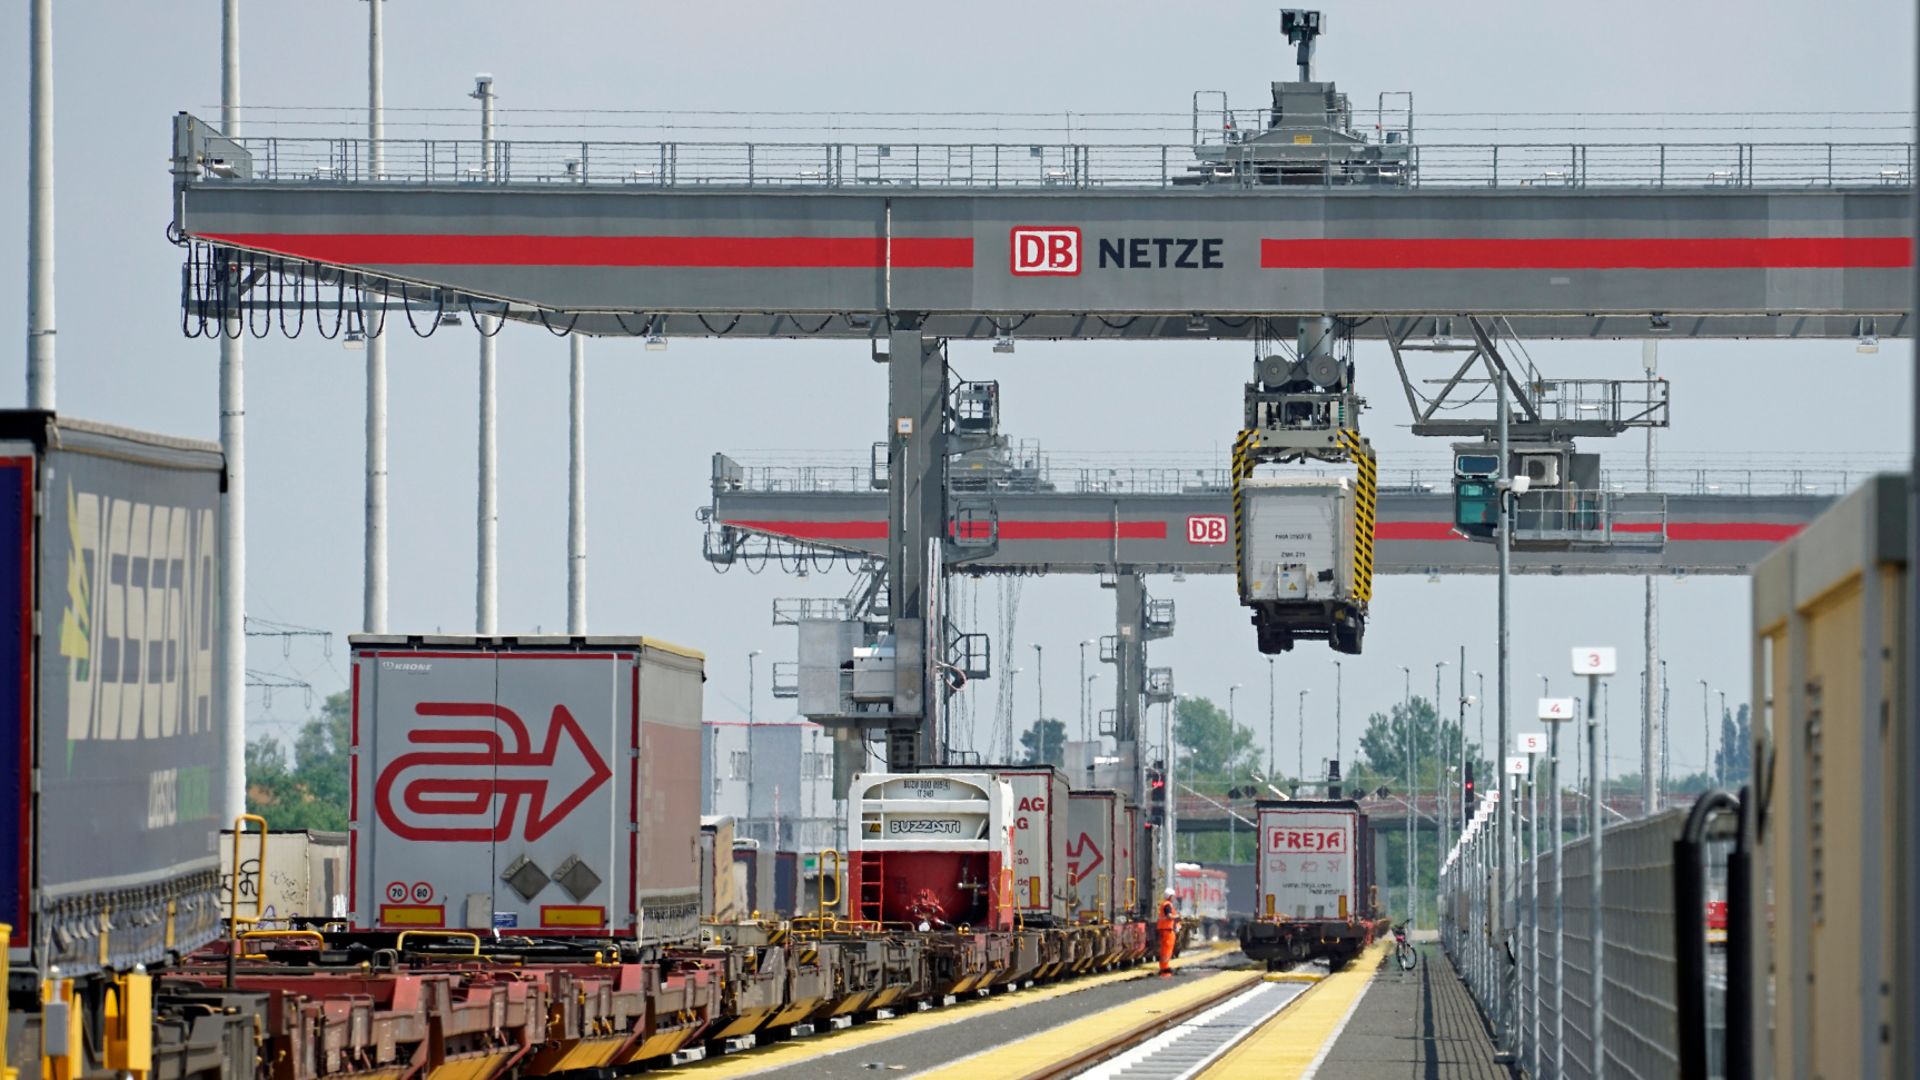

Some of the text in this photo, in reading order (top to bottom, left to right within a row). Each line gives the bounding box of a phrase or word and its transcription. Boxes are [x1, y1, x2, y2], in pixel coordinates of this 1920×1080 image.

[1018, 233, 1224, 269] DB NETZE
[1192, 519, 1225, 541] DB
[67, 491, 215, 741] DISSEGNA
[394, 663, 432, 671] KRONE
[1588, 654, 1600, 667] 3
[1551, 703, 1560, 714] 4
[1527, 738, 1536, 748] 5
[1515, 761, 1522, 770] 6
[1018, 796, 1045, 812] AG
[890, 820, 961, 834] BUZZATTI
[1273, 831, 1341, 850] FREJA
[392, 888, 403, 897] 70
[416, 888, 428, 897] 80
